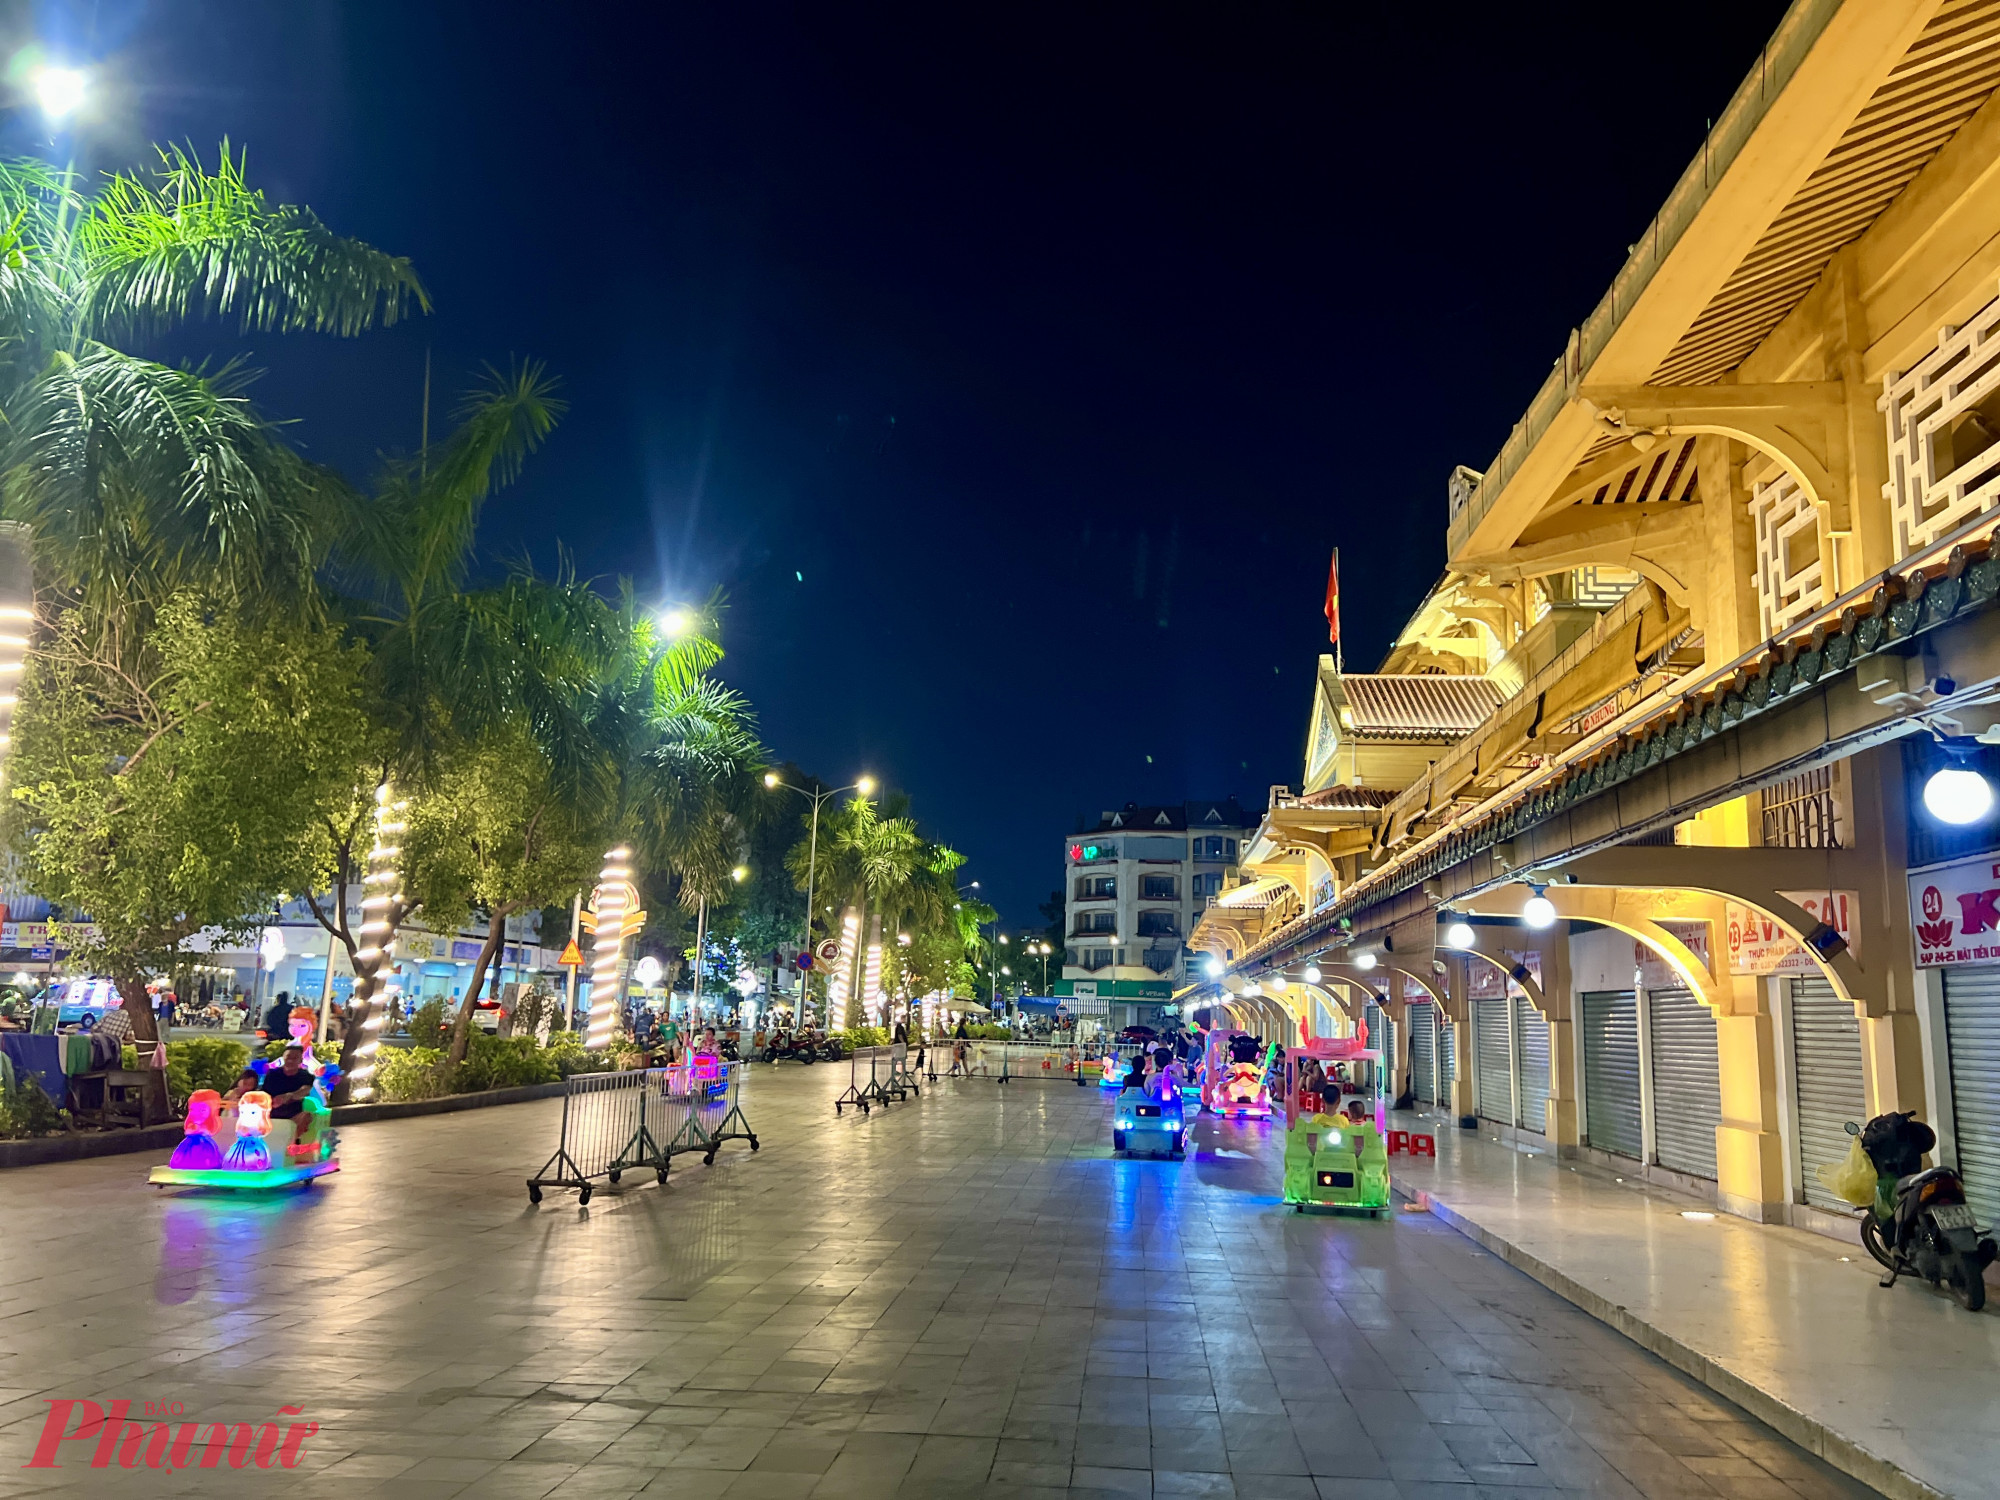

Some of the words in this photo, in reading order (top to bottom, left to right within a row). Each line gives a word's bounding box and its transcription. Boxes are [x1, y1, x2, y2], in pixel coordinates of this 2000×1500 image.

[1590, 700, 1615, 728] NHUNG
[1083, 844, 1119, 860] VPBank
[1924, 892, 1940, 914] 24
[26, 923, 95, 936] THƠNG
[1730, 927, 1740, 948] 23
